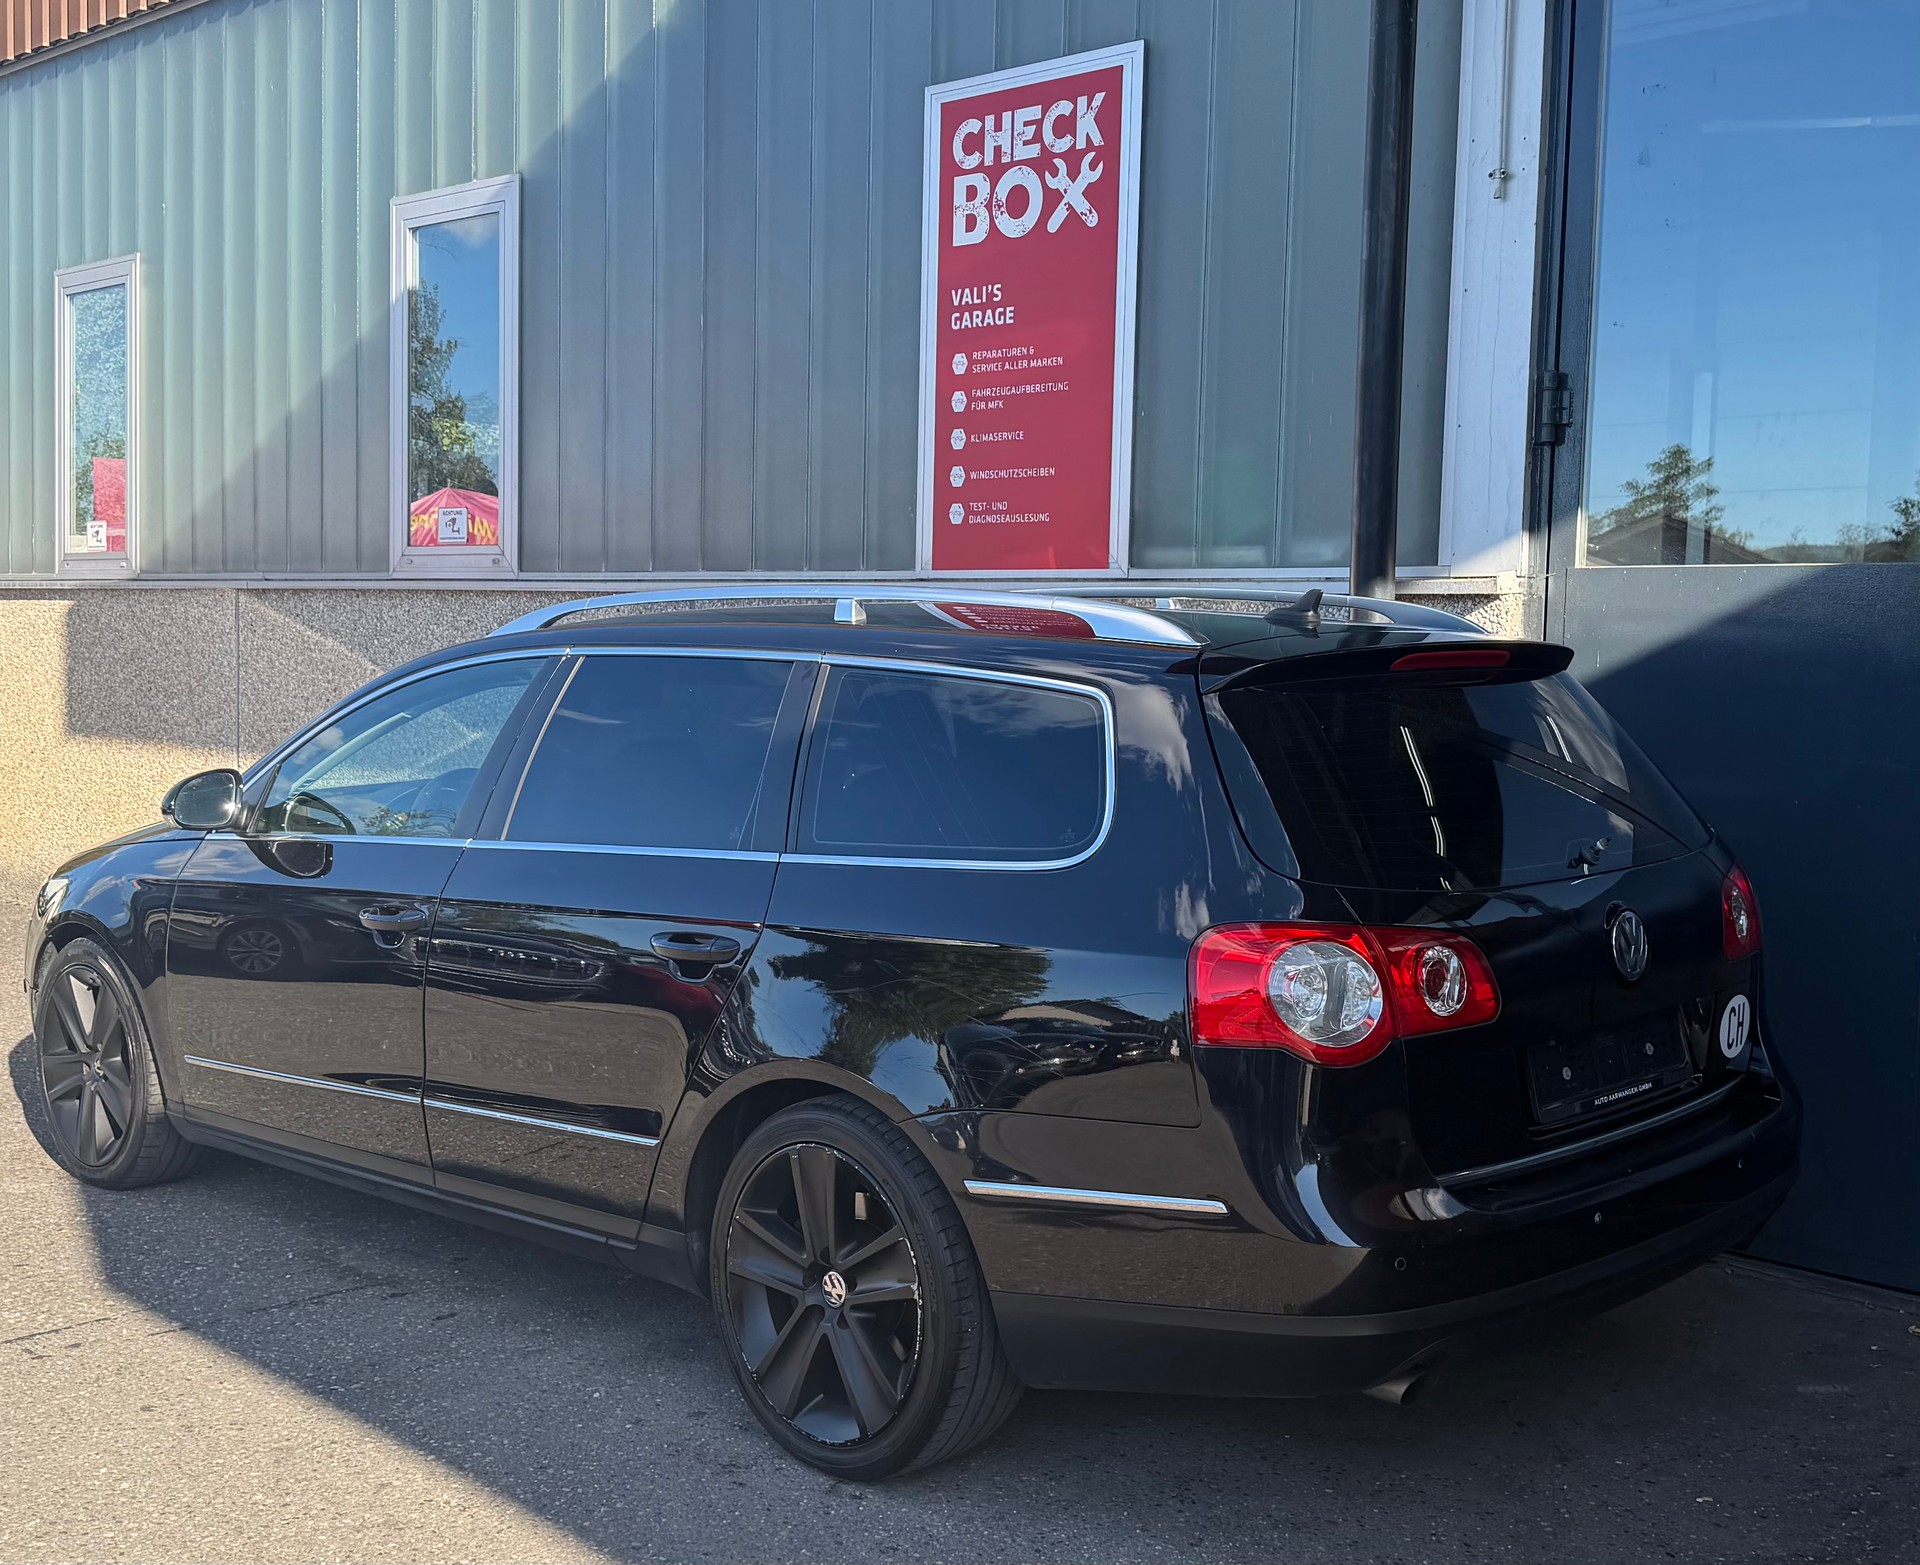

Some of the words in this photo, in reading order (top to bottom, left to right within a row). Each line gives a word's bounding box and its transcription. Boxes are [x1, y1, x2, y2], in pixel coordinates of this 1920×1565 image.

[953, 91, 1106, 170] CHECK
[953, 151, 1104, 247] BOX
[951, 284, 1002, 306] VALI'S
[951, 306, 1015, 330] GARAGE
[972, 347, 1027, 360] REPARATUREN
[1029, 346, 1035, 355] &
[972, 362, 1002, 374] SERVICE
[1004, 359, 1028, 370] ALLER
[1030, 356, 1063, 368] MARKEN
[971, 382, 1069, 397] FAHRZEUGAUFBEREITUNG
[971, 400, 986, 411] FÜR
[988, 400, 1004, 410] MFK
[970, 431, 1024, 442] KLIMASERVICE
[970, 467, 1055, 479] WINDSCHUTZSCHEIBEN
[969, 502, 990, 511] TEST-
[991, 501, 1008, 511] UND
[968, 512, 1050, 524] DIAGNOSEAUSLESUNG
[1727, 1002, 1746, 1051] CH
[1594, 1096, 1609, 1106] AUTO
